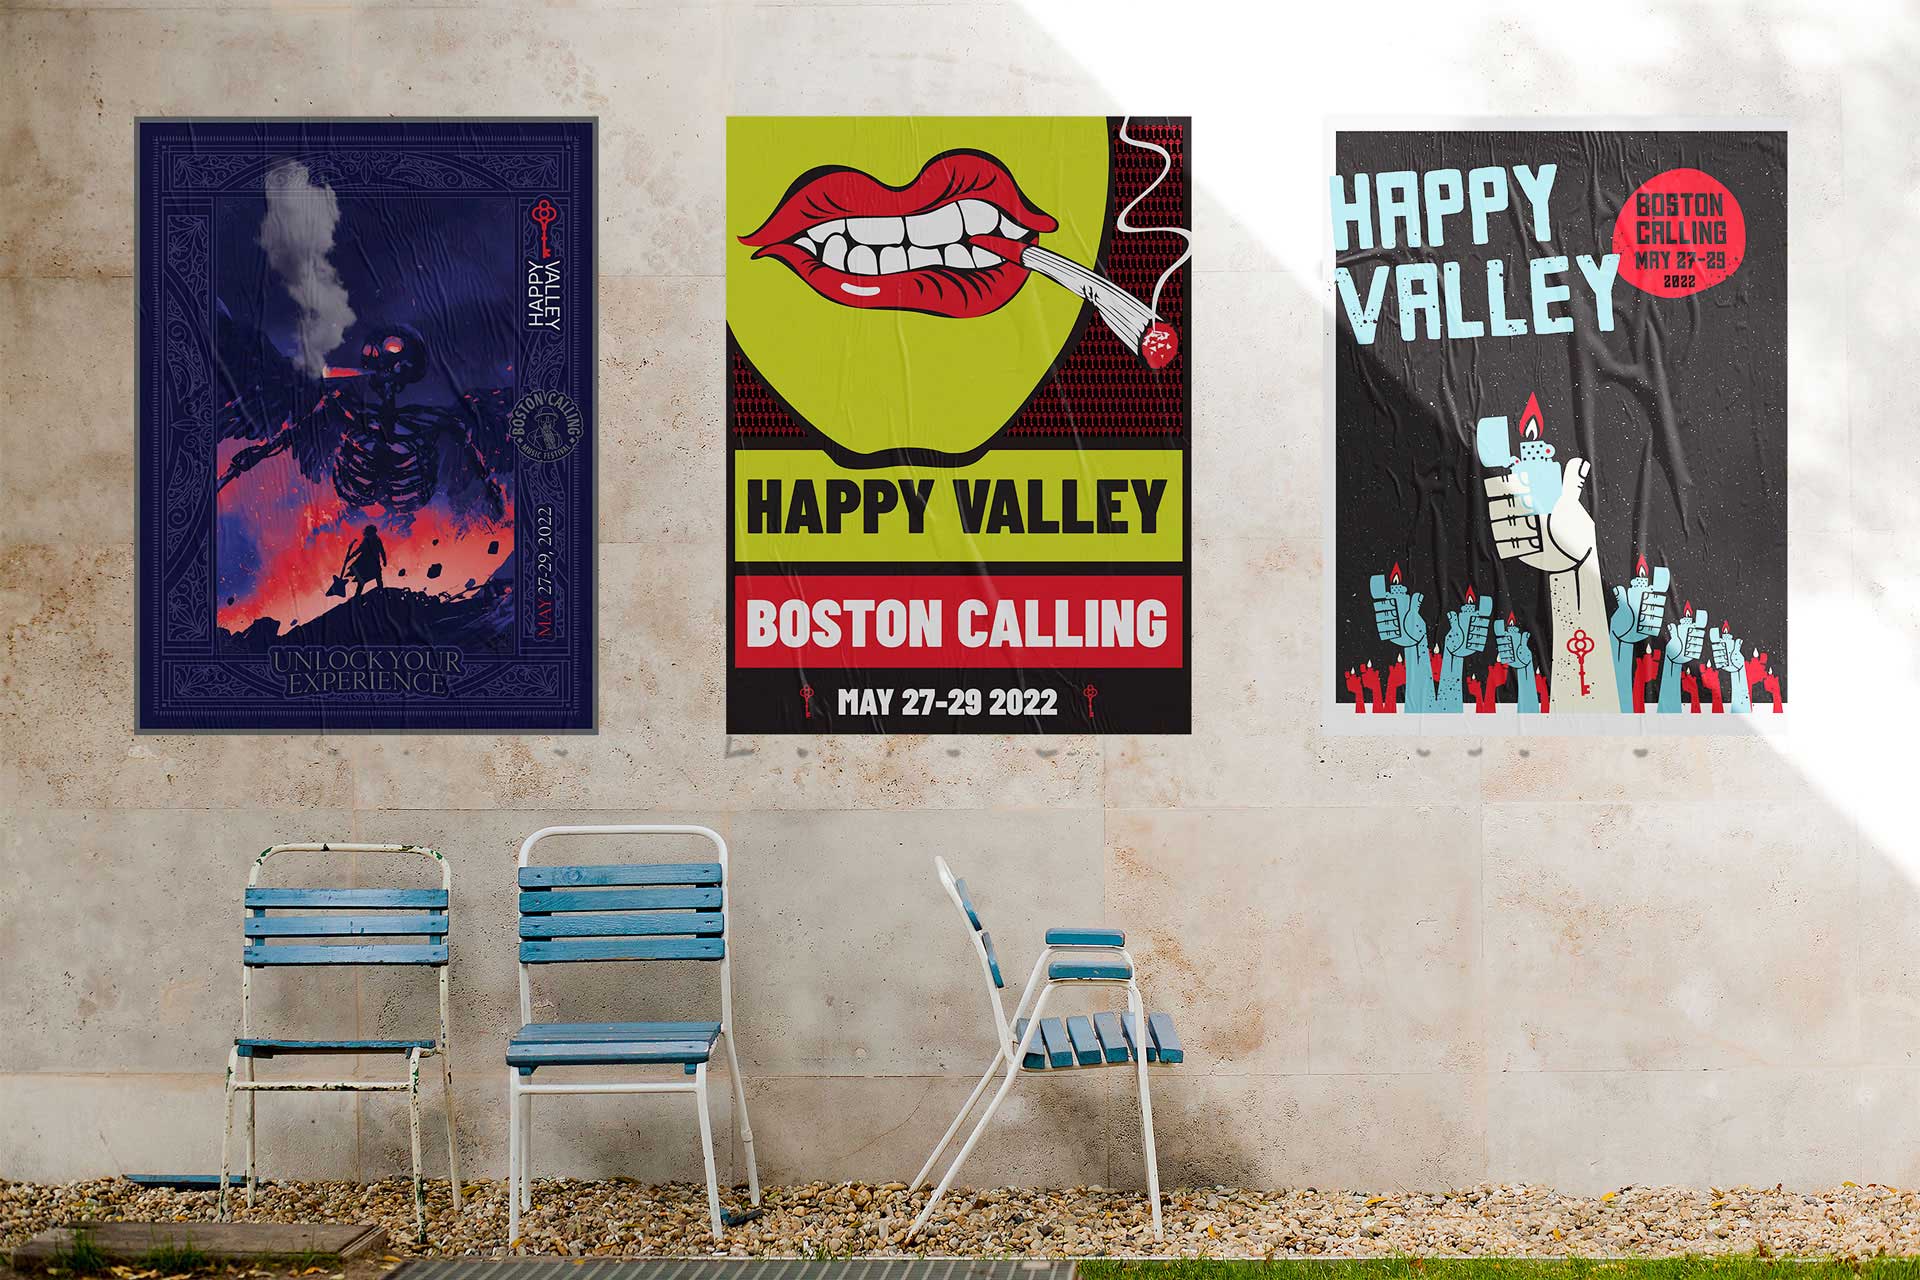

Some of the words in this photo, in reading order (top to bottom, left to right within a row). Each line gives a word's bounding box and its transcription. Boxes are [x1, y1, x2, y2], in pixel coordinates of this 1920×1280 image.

[1329, 164, 1557, 251] HAPPY
[1636, 193, 1723, 216] BOSTON
[1636, 221, 1727, 244] CALLING
[1635, 251, 1670, 269] MAY
[1677, 251, 1725, 269] 27-29
[528, 260, 543, 325] HAPPY
[545, 260, 560, 331] VALLEY
[1335, 253, 1620, 345] VALLEY
[1664, 275, 1695, 288] 2022
[512, 393, 544, 435] BOSTON
[548, 392, 580, 435] CALLING
[521, 444, 541, 459] MUSIC
[543, 444, 571, 460] FESTIVAL
[747, 479, 935, 534] HAPPY
[952, 479, 1168, 534] VALLEY
[538, 507, 552, 546] 2022
[538, 551, 554, 595] 27-29,
[538, 599, 552, 637] MAY
[747, 599, 943, 648] BOSTON
[957, 599, 1168, 648] CALLING
[274, 650, 385, 673] UNLOCK
[386, 650, 461, 673] YOUR
[287, 671, 445, 695] EXPERIENCE
[838, 689, 894, 716] MAY
[902, 689, 982, 716] 27-29
[989, 689, 1058, 716] 2022
